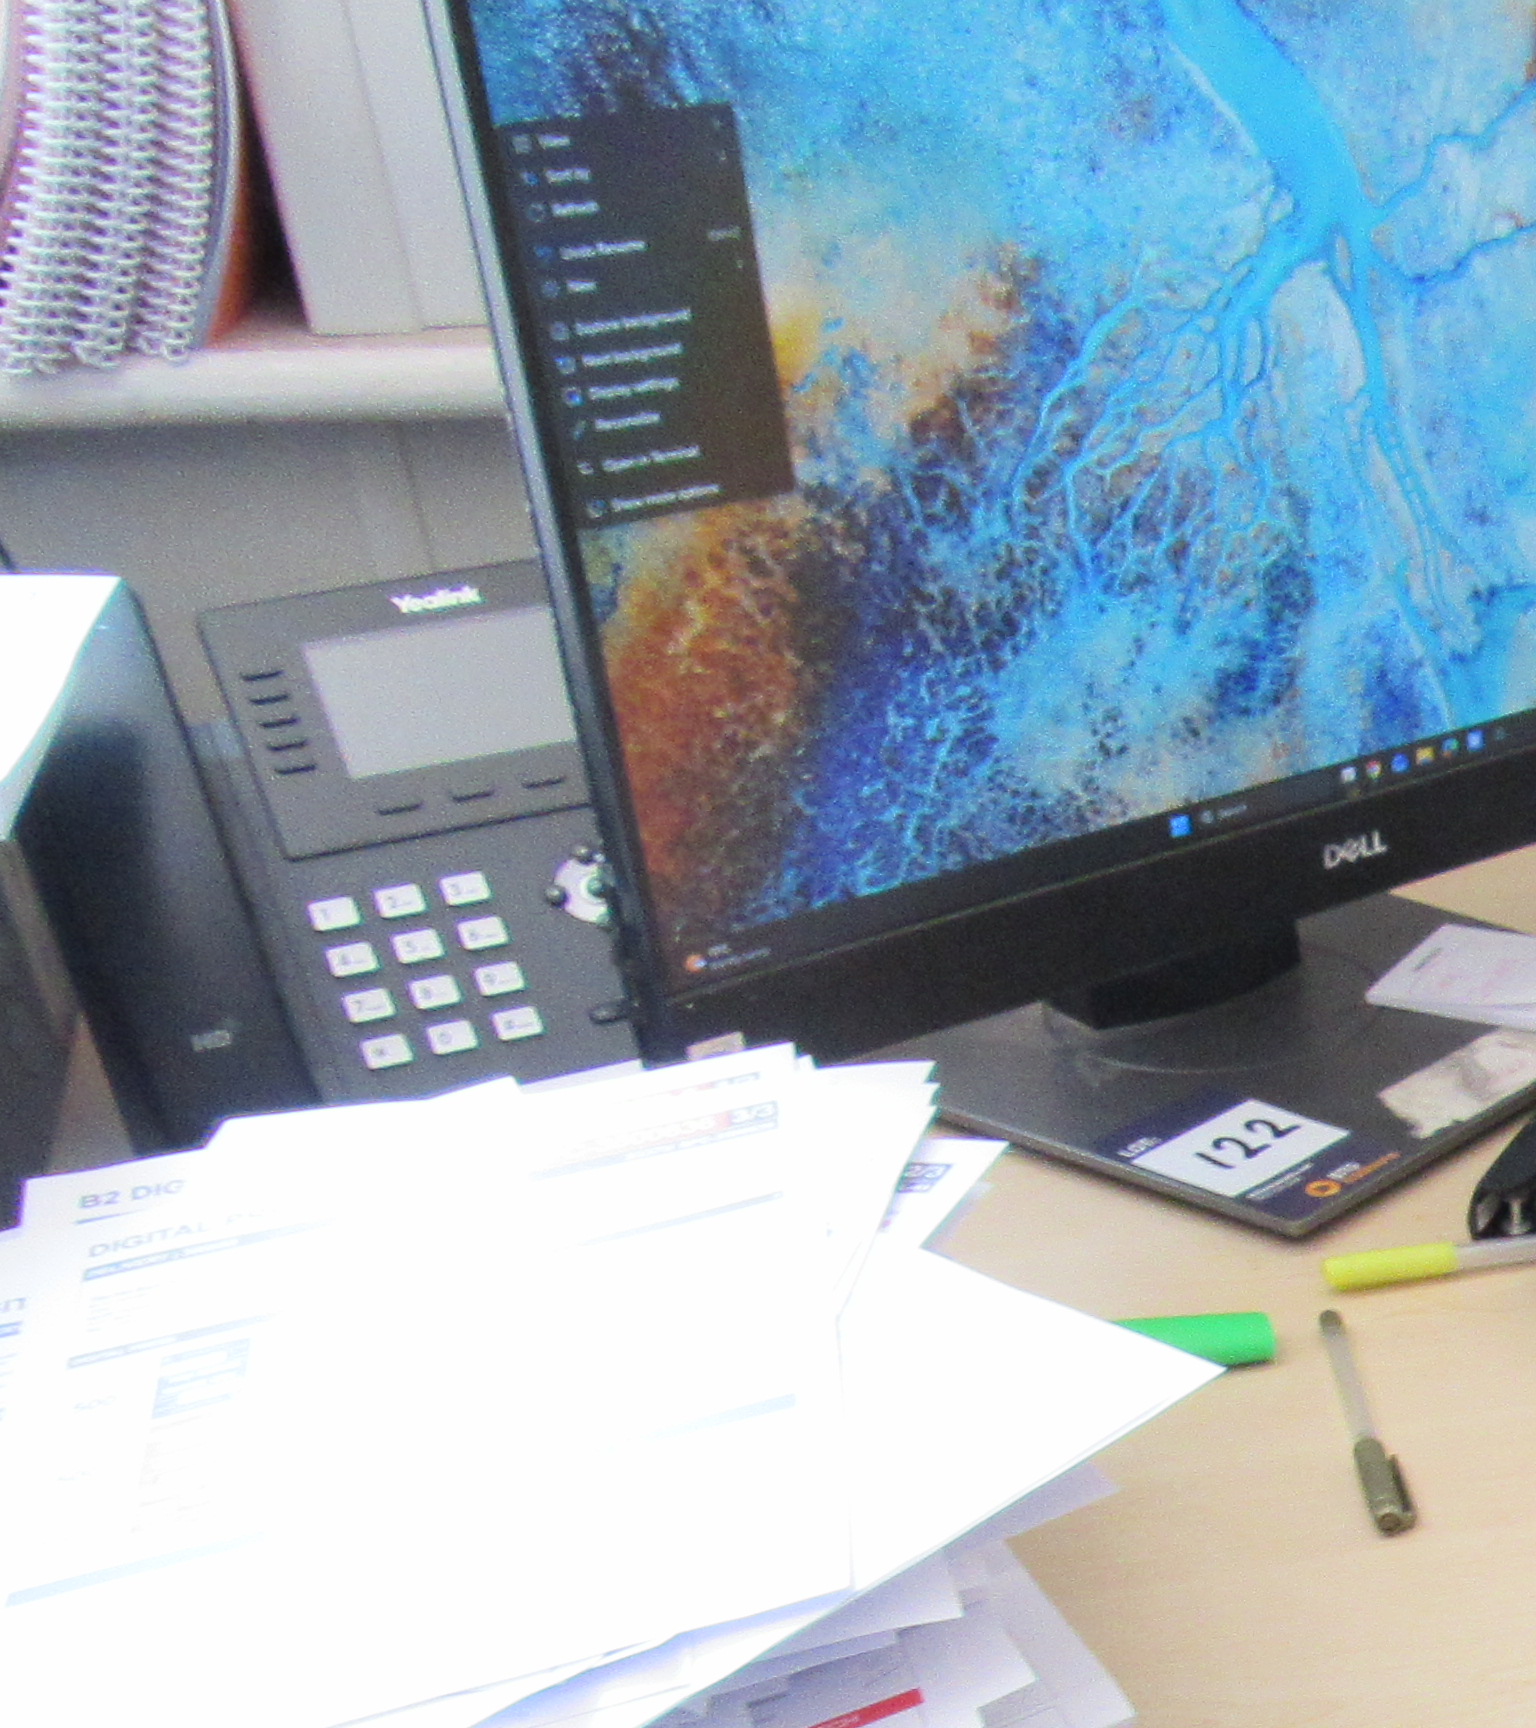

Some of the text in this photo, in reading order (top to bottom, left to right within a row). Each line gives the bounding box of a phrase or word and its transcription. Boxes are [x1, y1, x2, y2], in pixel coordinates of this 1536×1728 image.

[1322, 829, 1389, 871] DELL
[1195, 1119, 1304, 1169] 122
[78, 1190, 121, 1210] B2
